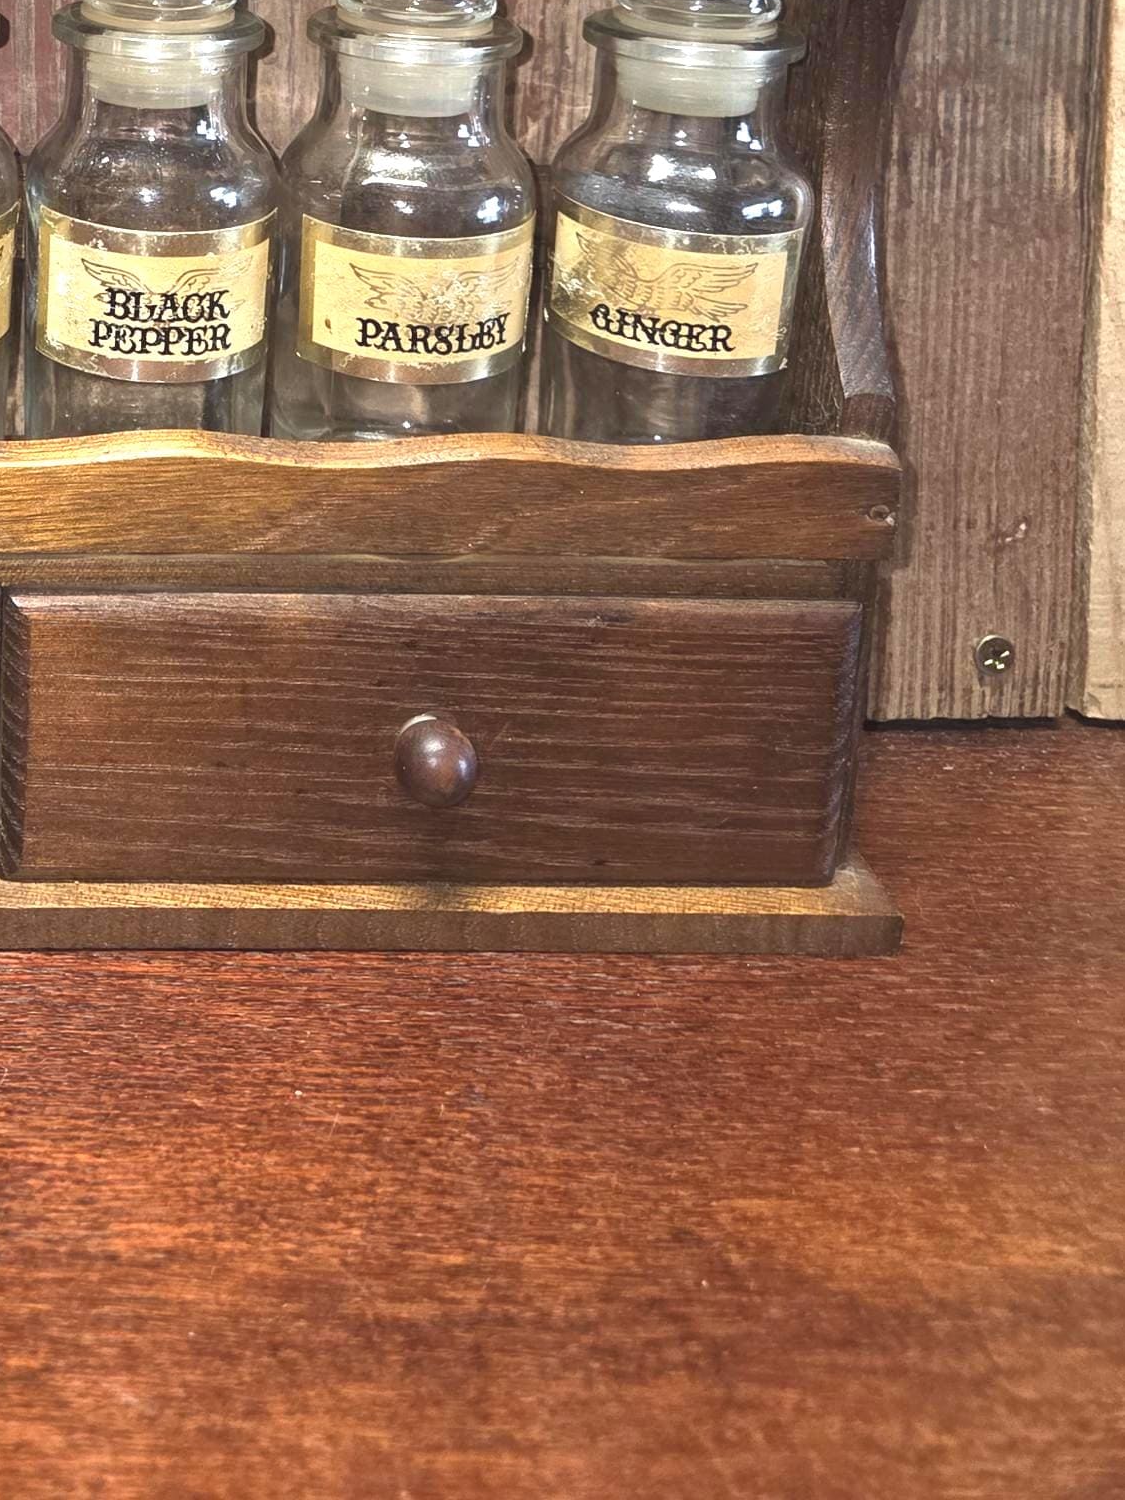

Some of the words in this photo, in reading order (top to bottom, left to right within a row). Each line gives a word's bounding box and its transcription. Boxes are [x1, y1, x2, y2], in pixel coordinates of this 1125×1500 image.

[103, 287, 231, 323] BLACK
[88, 317, 231, 357] PEPPER
[355, 312, 511, 356] PARSLEY
[589, 303, 736, 353] GINGER
